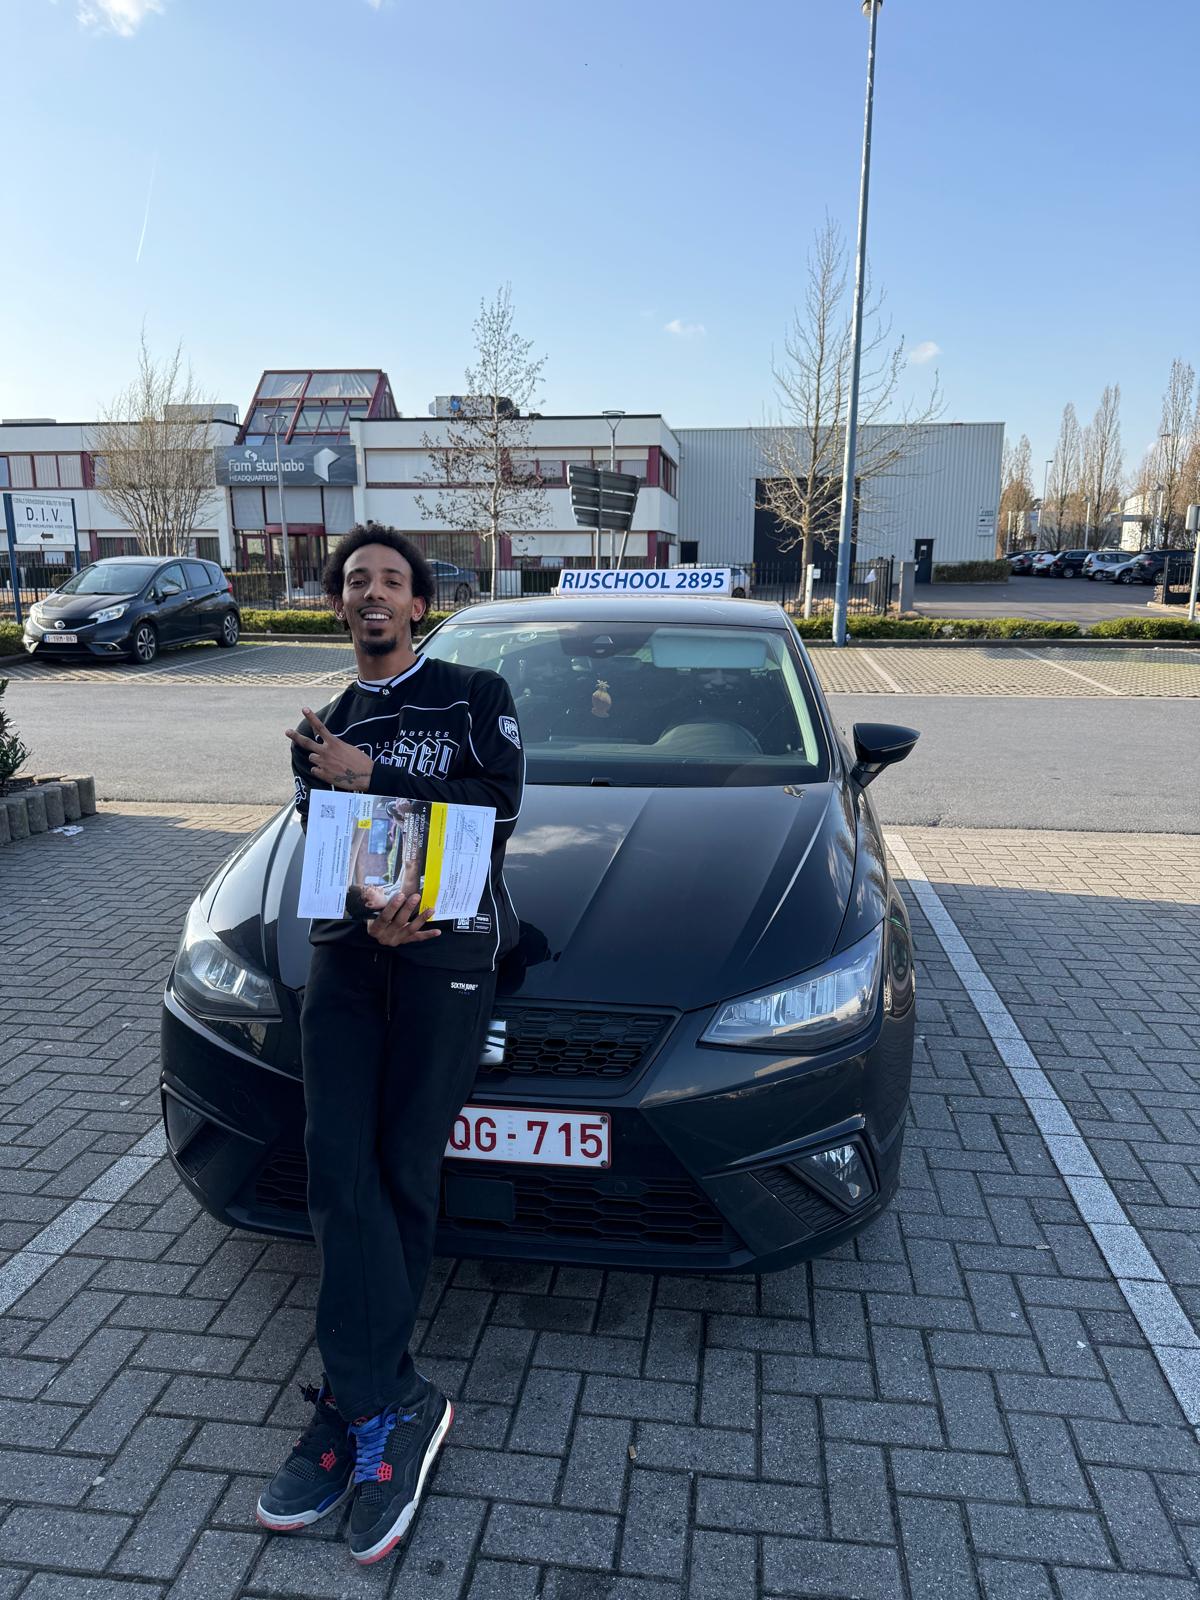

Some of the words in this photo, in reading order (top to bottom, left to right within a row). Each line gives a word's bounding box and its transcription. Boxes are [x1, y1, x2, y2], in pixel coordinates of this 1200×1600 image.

[229, 474, 278, 483] HEADQUARTERS
[562, 572, 670, 589] RIJSCHOOL
[675, 572, 725, 589] 2895
[399, 730, 449, 738] NGELES
